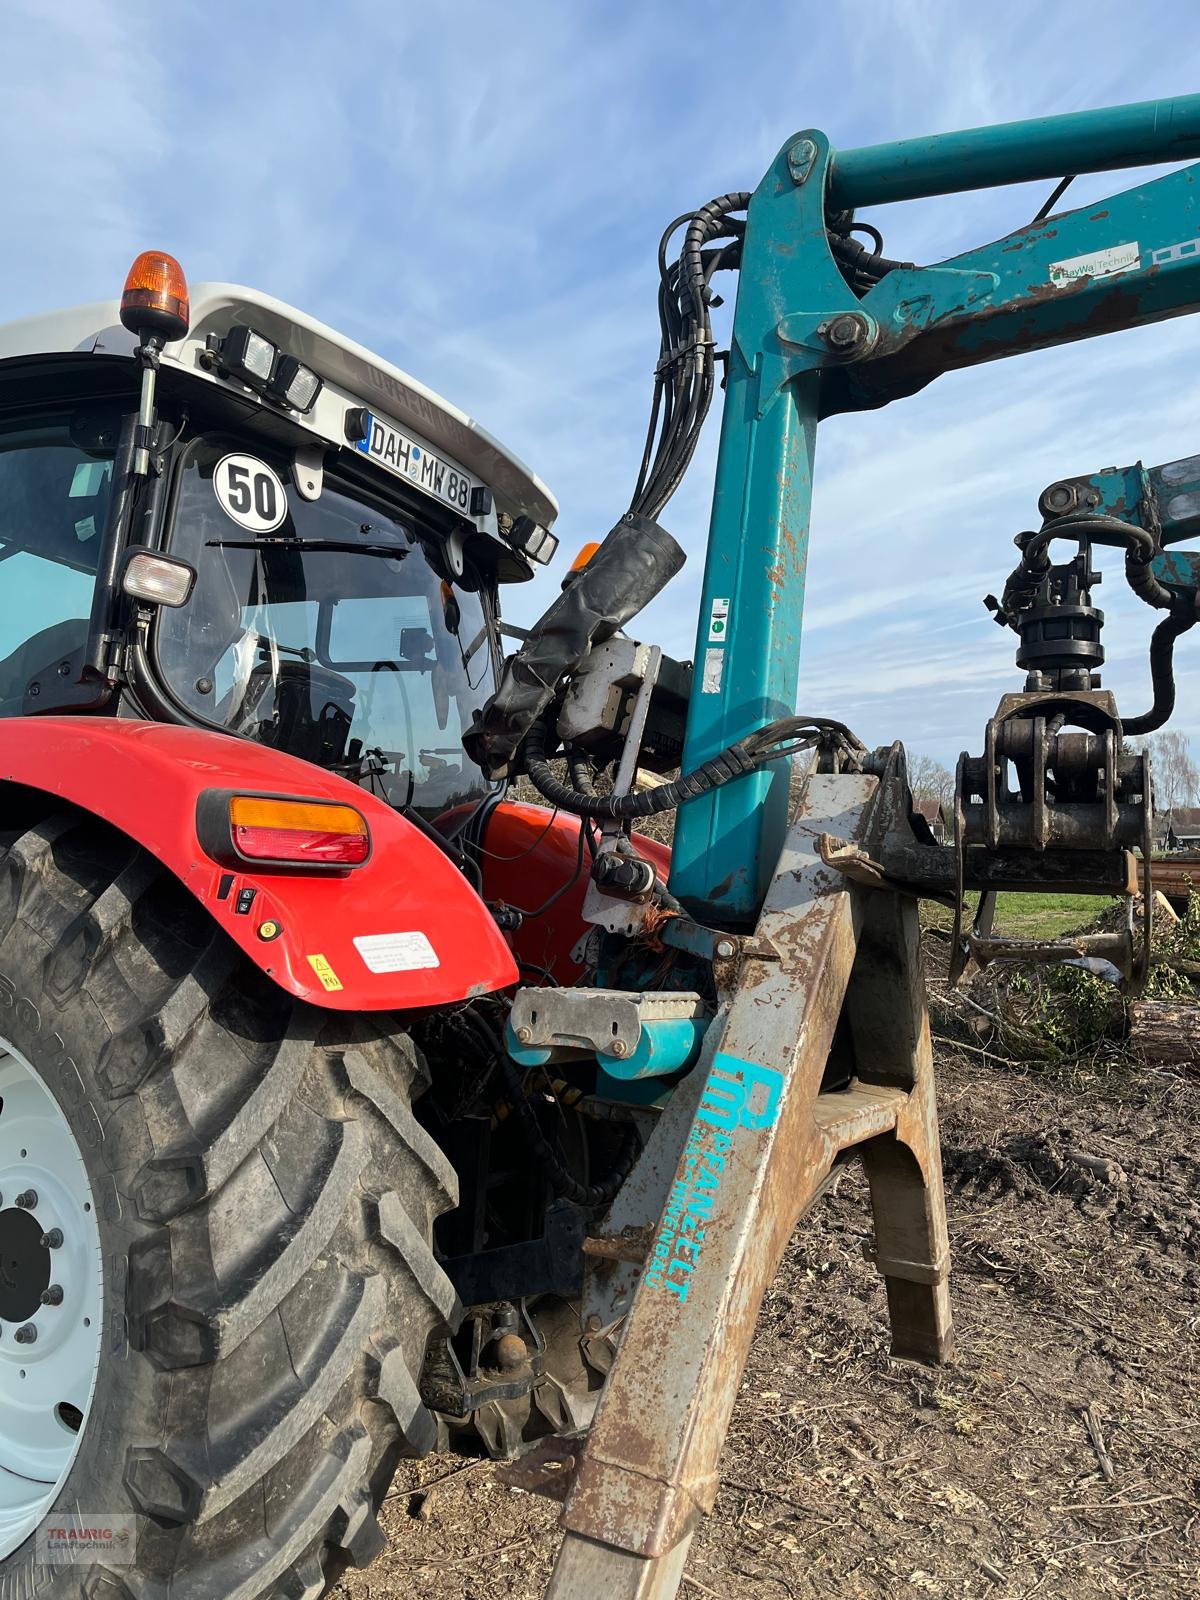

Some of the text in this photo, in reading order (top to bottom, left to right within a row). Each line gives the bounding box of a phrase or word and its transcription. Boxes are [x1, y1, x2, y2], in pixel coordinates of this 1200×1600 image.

[1096, 251, 1135, 270] Technik
[227, 463, 277, 521] 50
[370, 422, 469, 508] DAH MW 88
[663, 1131, 733, 1304] PFANZELT
